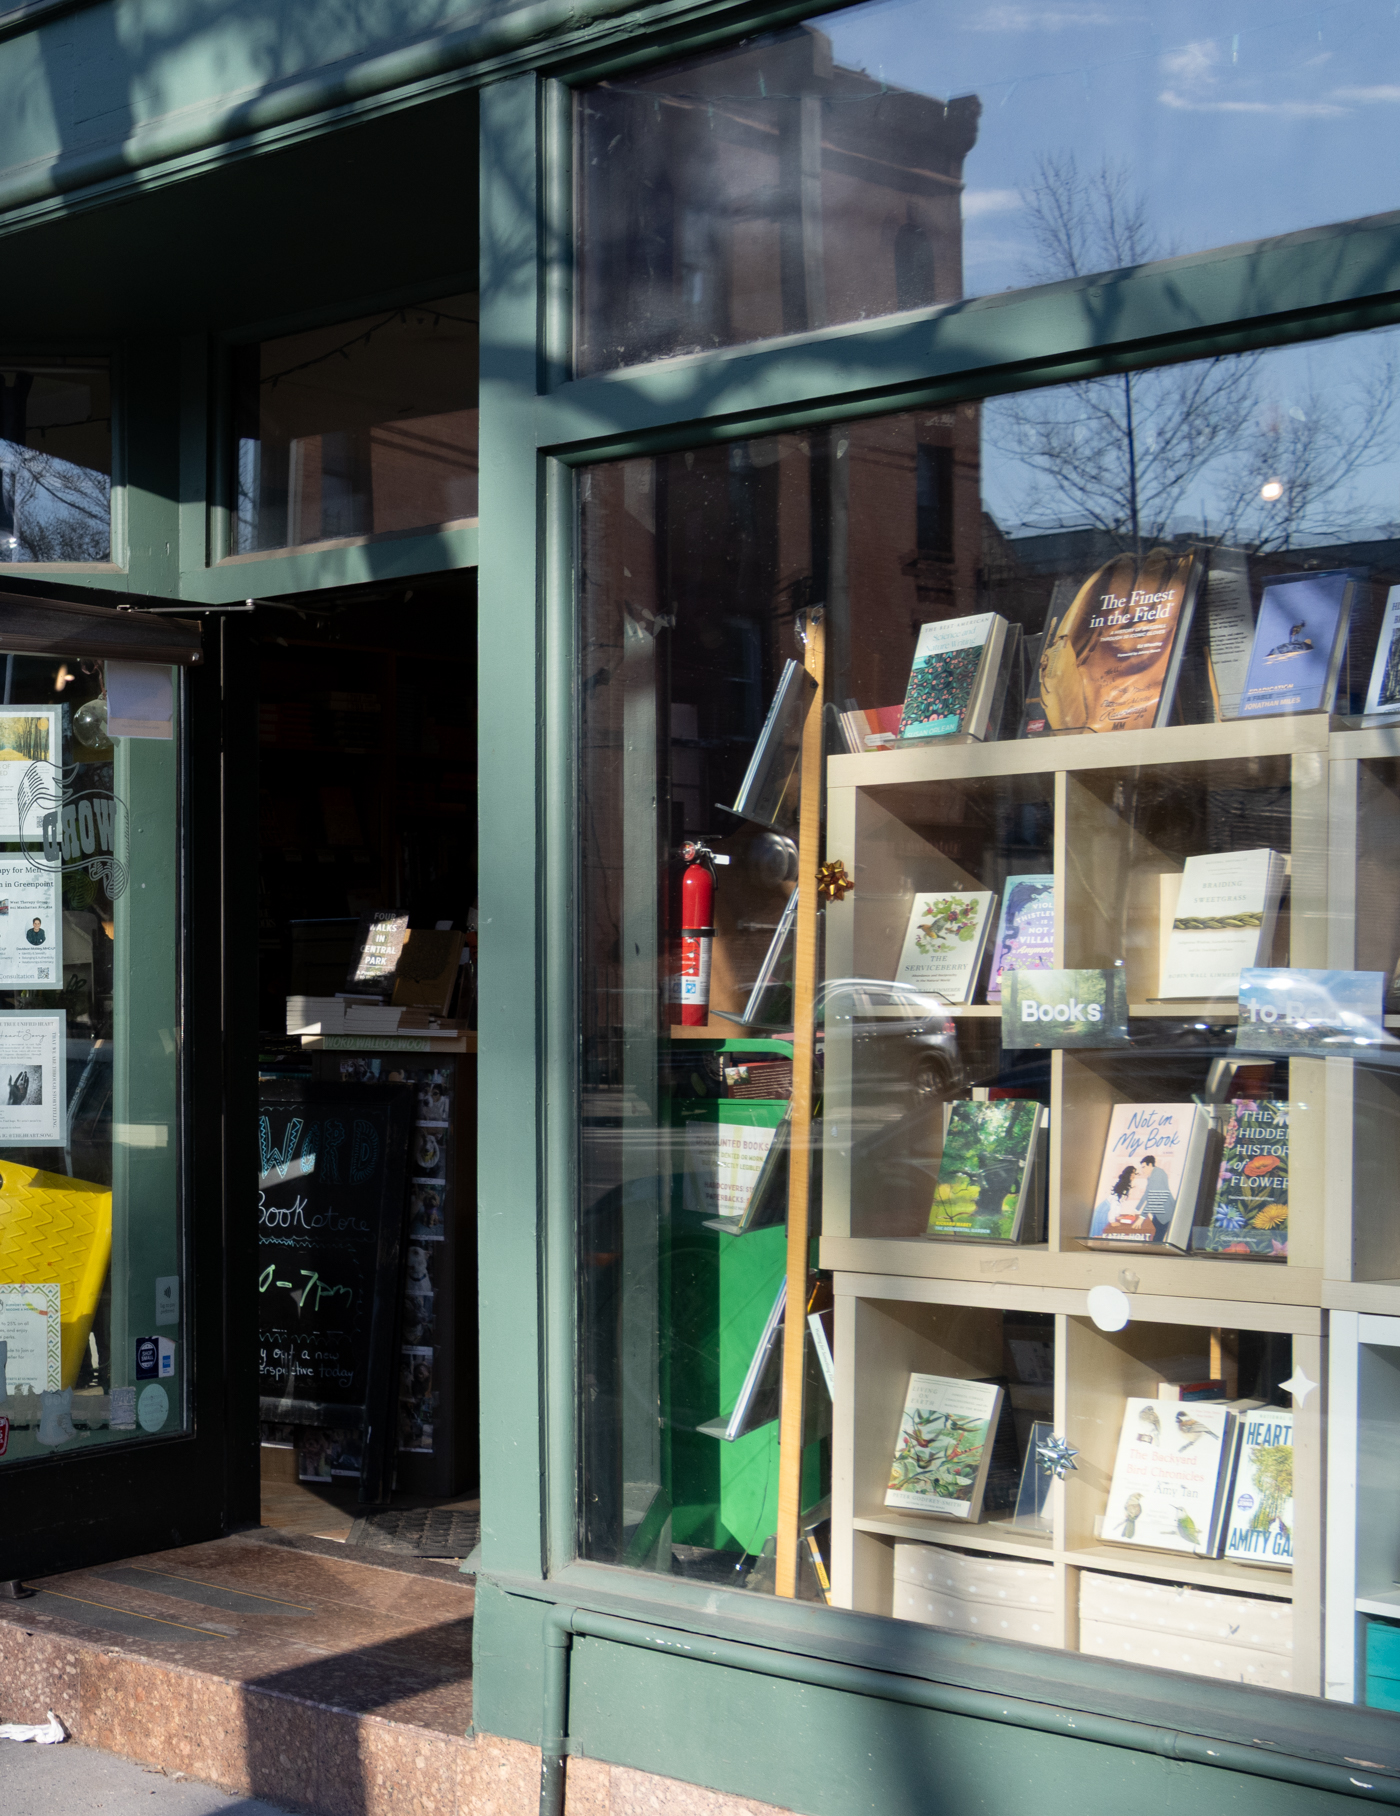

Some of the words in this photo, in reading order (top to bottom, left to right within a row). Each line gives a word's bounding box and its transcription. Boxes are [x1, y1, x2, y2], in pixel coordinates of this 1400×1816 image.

[1100, 594, 1127, 610] The
[1129, 590, 1176, 606] Finest
[1089, 614, 1105, 628] in
[1107, 610, 1131, 626] the
[1132, 603, 1172, 622] Field
[939, 623, 954, 631] BEST
[956, 617, 989, 628] AMERICAN
[933, 630, 957, 642] Science
[960, 626, 976, 637] and
[1248, 684, 1294, 695] ERADICATION
[1244, 700, 1279, 710] JONATHAN
[1280, 697, 1301, 705] MILES
[907, 728, 928, 738] SUSAN
[929, 724, 955, 735] ORLEAN
[1112, 722, 1126, 730] MM
[1202, 881, 1242, 889] BRAIDING
[1194, 895, 1247, 903] SWEETGRASS
[374, 912, 397, 920] FOUR
[368, 923, 397, 932] WALKS
[376, 934, 386, 942] IN
[360, 945, 396, 954] CENTRAL
[365, 956, 388, 965] PARK
[1022, 998, 1102, 1022] Books
[1246, 998, 1278, 1024] to
[325, 1036, 354, 1048] WORD
[356, 1036, 380, 1049] WALL
[383, 1037, 397, 1048] OF
[1127, 1110, 1158, 1130] Not
[1158, 1114, 1173, 1126] in
[1242, 1111, 1272, 1122] THE
[1238, 1128, 1289, 1139] HIDDE
[258, 1115, 379, 1185] WORD
[696, 1136, 741, 1149] DISCOUNTED
[743, 1141, 770, 1152] BOOKS
[1112, 1131, 1145, 1158] My
[1145, 1128, 1180, 1150] Book
[1233, 1158, 1250, 1173] of
[1102, 1233, 1126, 1241] KATIE
[1129, 1233, 1152, 1241] HOLT
[302, 1350, 310, 1360] a
[315, 1351, 340, 1360] new
[318, 1363, 354, 1388] today
[912, 1386, 938, 1395] LIVING
[911, 1399, 935, 1407] EARTH
[1246, 1422, 1293, 1447] HEART
[1130, 1449, 1148, 1460] The
[1152, 1451, 1197, 1467] Backyard
[1127, 1464, 1147, 1477] Bird
[1151, 1467, 1205, 1484] Chronicles
[1154, 1483, 1176, 1498] Amy
[1181, 1486, 1199, 1500] Tan
[893, 1492, 910, 1500] PETER
[912, 1495, 962, 1508] GODFREY-SMITH
[1229, 1527, 1271, 1555] AMITY
